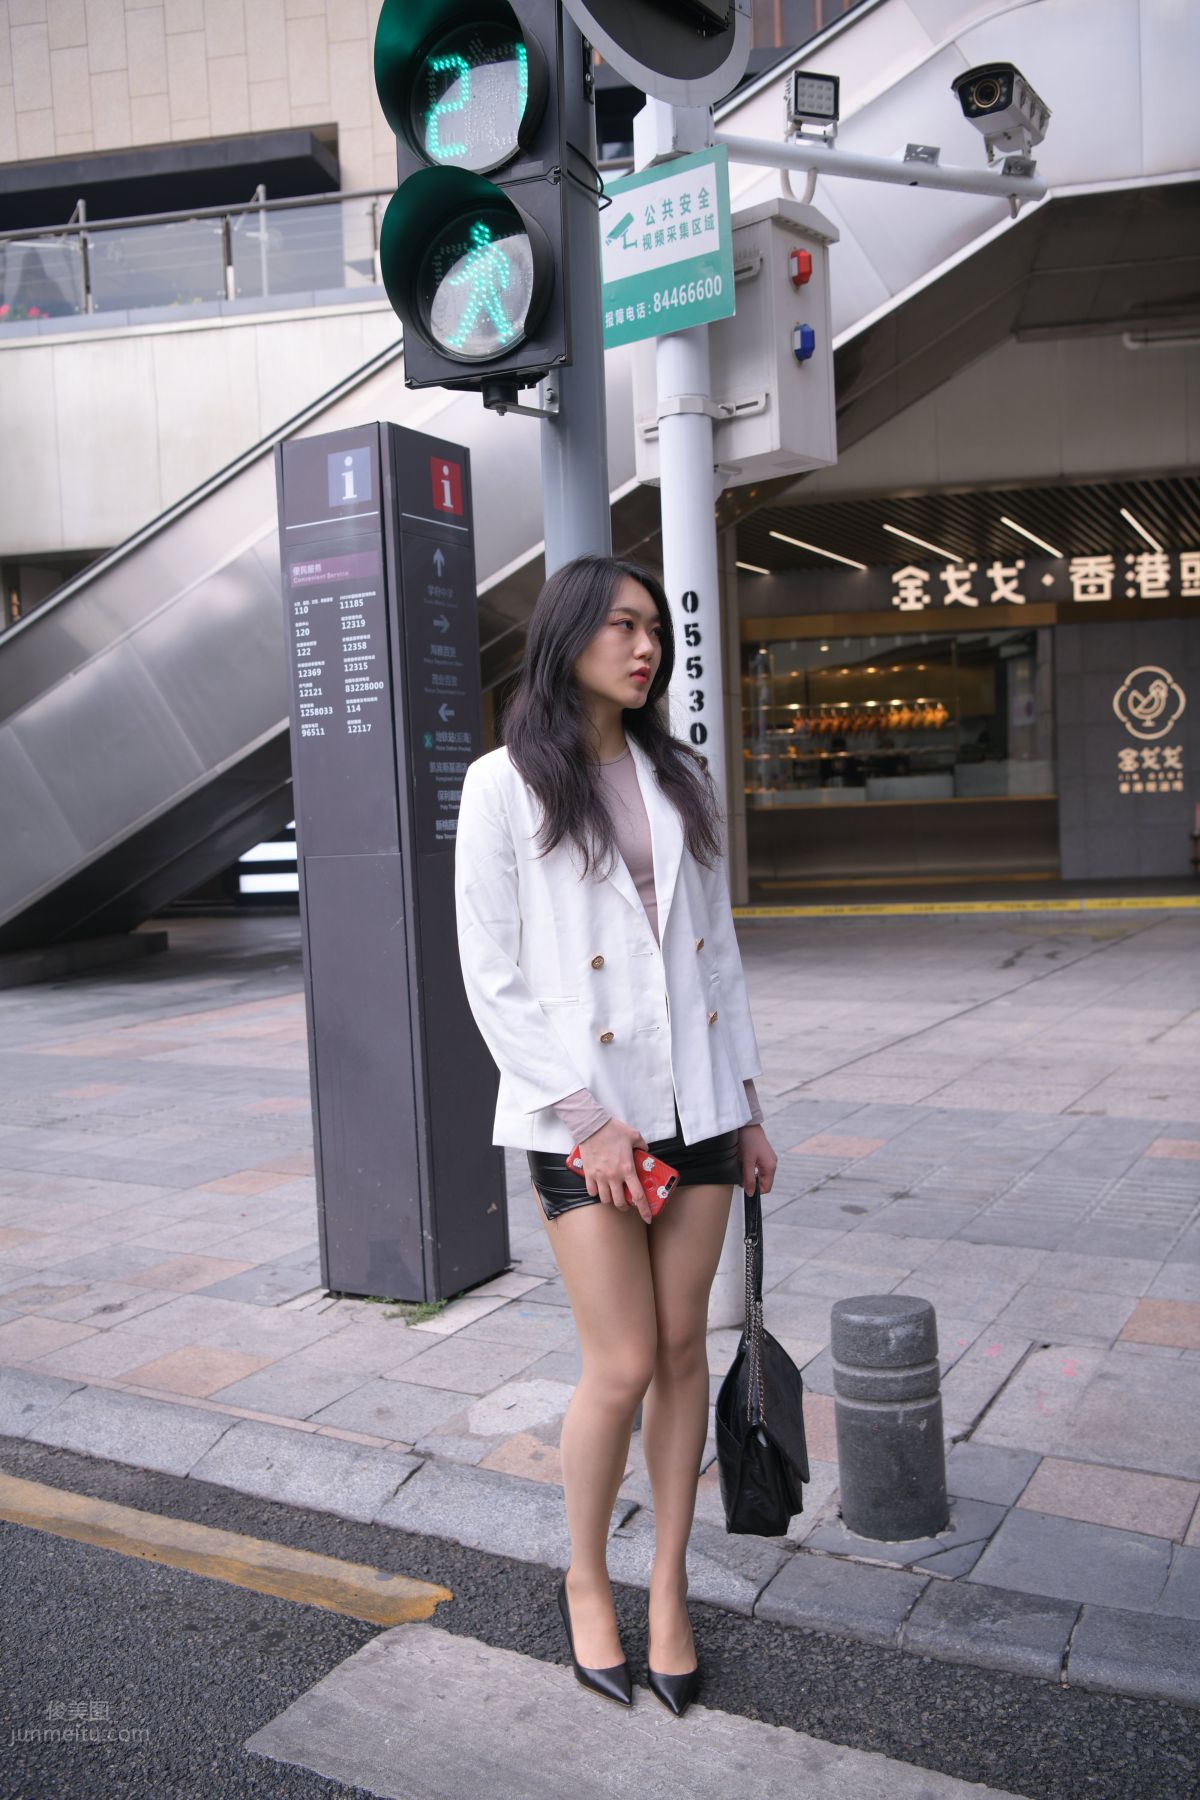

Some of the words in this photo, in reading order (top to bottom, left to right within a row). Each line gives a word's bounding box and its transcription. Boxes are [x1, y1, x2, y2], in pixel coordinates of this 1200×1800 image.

[644, 187, 710, 226] 公共安全
[642, 214, 715, 251] 视频采集区域
[340, 599, 364, 610] 11185
[294, 606, 309, 616] 110
[342, 619, 366, 630] 12319
[295, 628, 310, 637] 120
[343, 642, 367, 652] 12358
[297, 648, 311, 657] 122
[344, 662, 368, 672] 12315
[681, 590, 708, 745] 05530
[298, 668, 322, 678] 12369
[345, 681, 384, 693] 83228000
[299, 688, 323, 698] 12121
[301, 706, 334, 717] 1258033
[347, 704, 361, 713] 114
[301, 728, 325, 737] 96511
[347, 724, 372, 734] 12117
